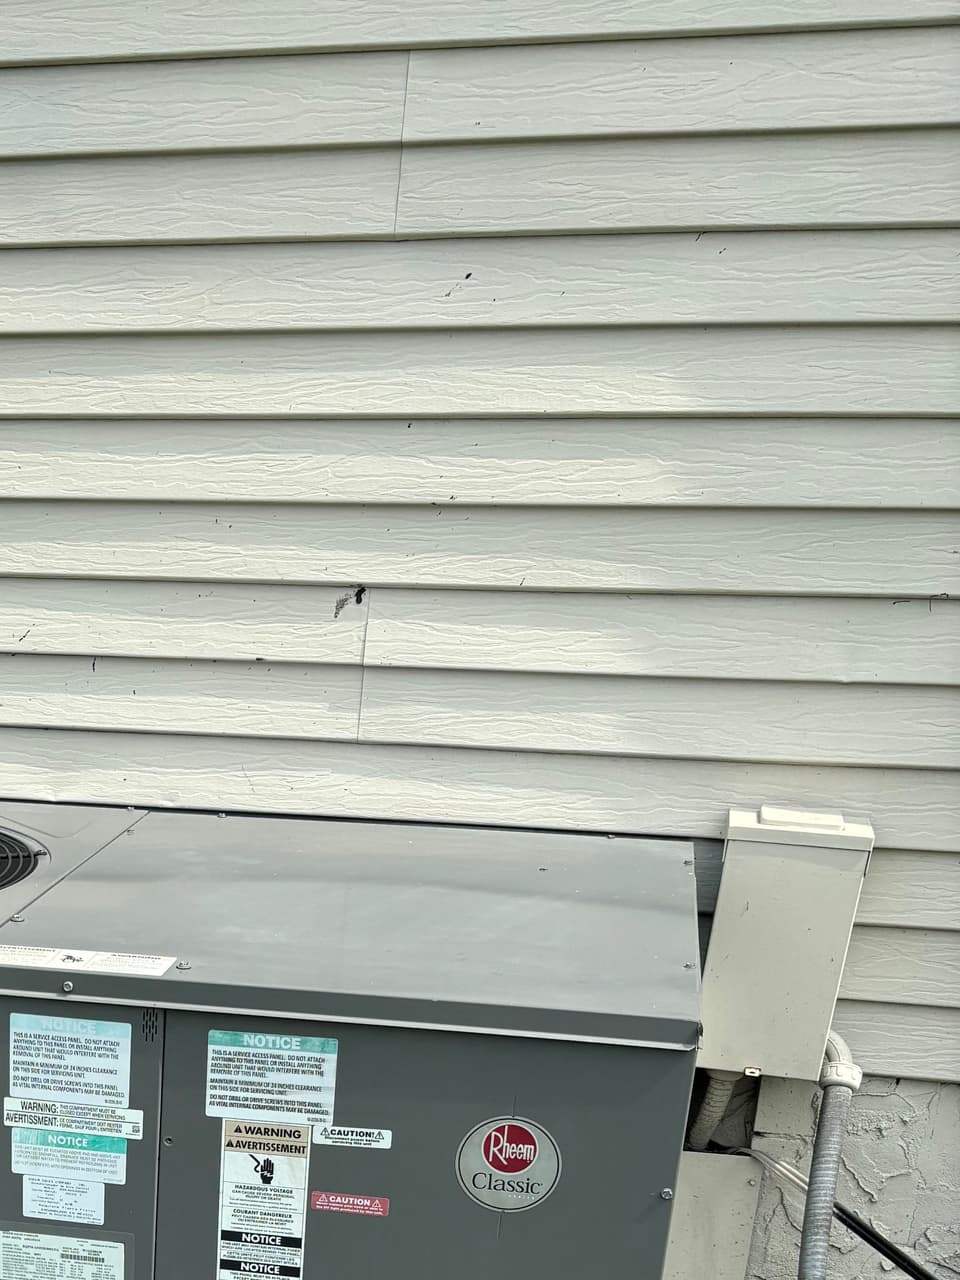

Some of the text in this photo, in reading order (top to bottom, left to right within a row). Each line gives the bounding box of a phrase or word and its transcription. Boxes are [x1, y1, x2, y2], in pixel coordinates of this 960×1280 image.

[42, 1019, 96, 1034] NOTICE
[243, 1034, 301, 1050] NOTICE
[21, 1100, 59, 1114] WARNING:
[244, 1126, 302, 1139] WARNING
[331, 1129, 374, 1138] CAUTION!
[48, 1135, 89, 1147] NOTICE
[235, 1140, 306, 1155] AVERTISSEMENT
[489, 1125, 535, 1166] Rheem
[235, 1184, 268, 1192] HAZARDOUS
[472, 1172, 541, 1195] Classic
[330, 1196, 370, 1206] CAUTION
[242, 1233, 281, 1246] NOTICE
[241, 1262, 280, 1275] NOTICE
